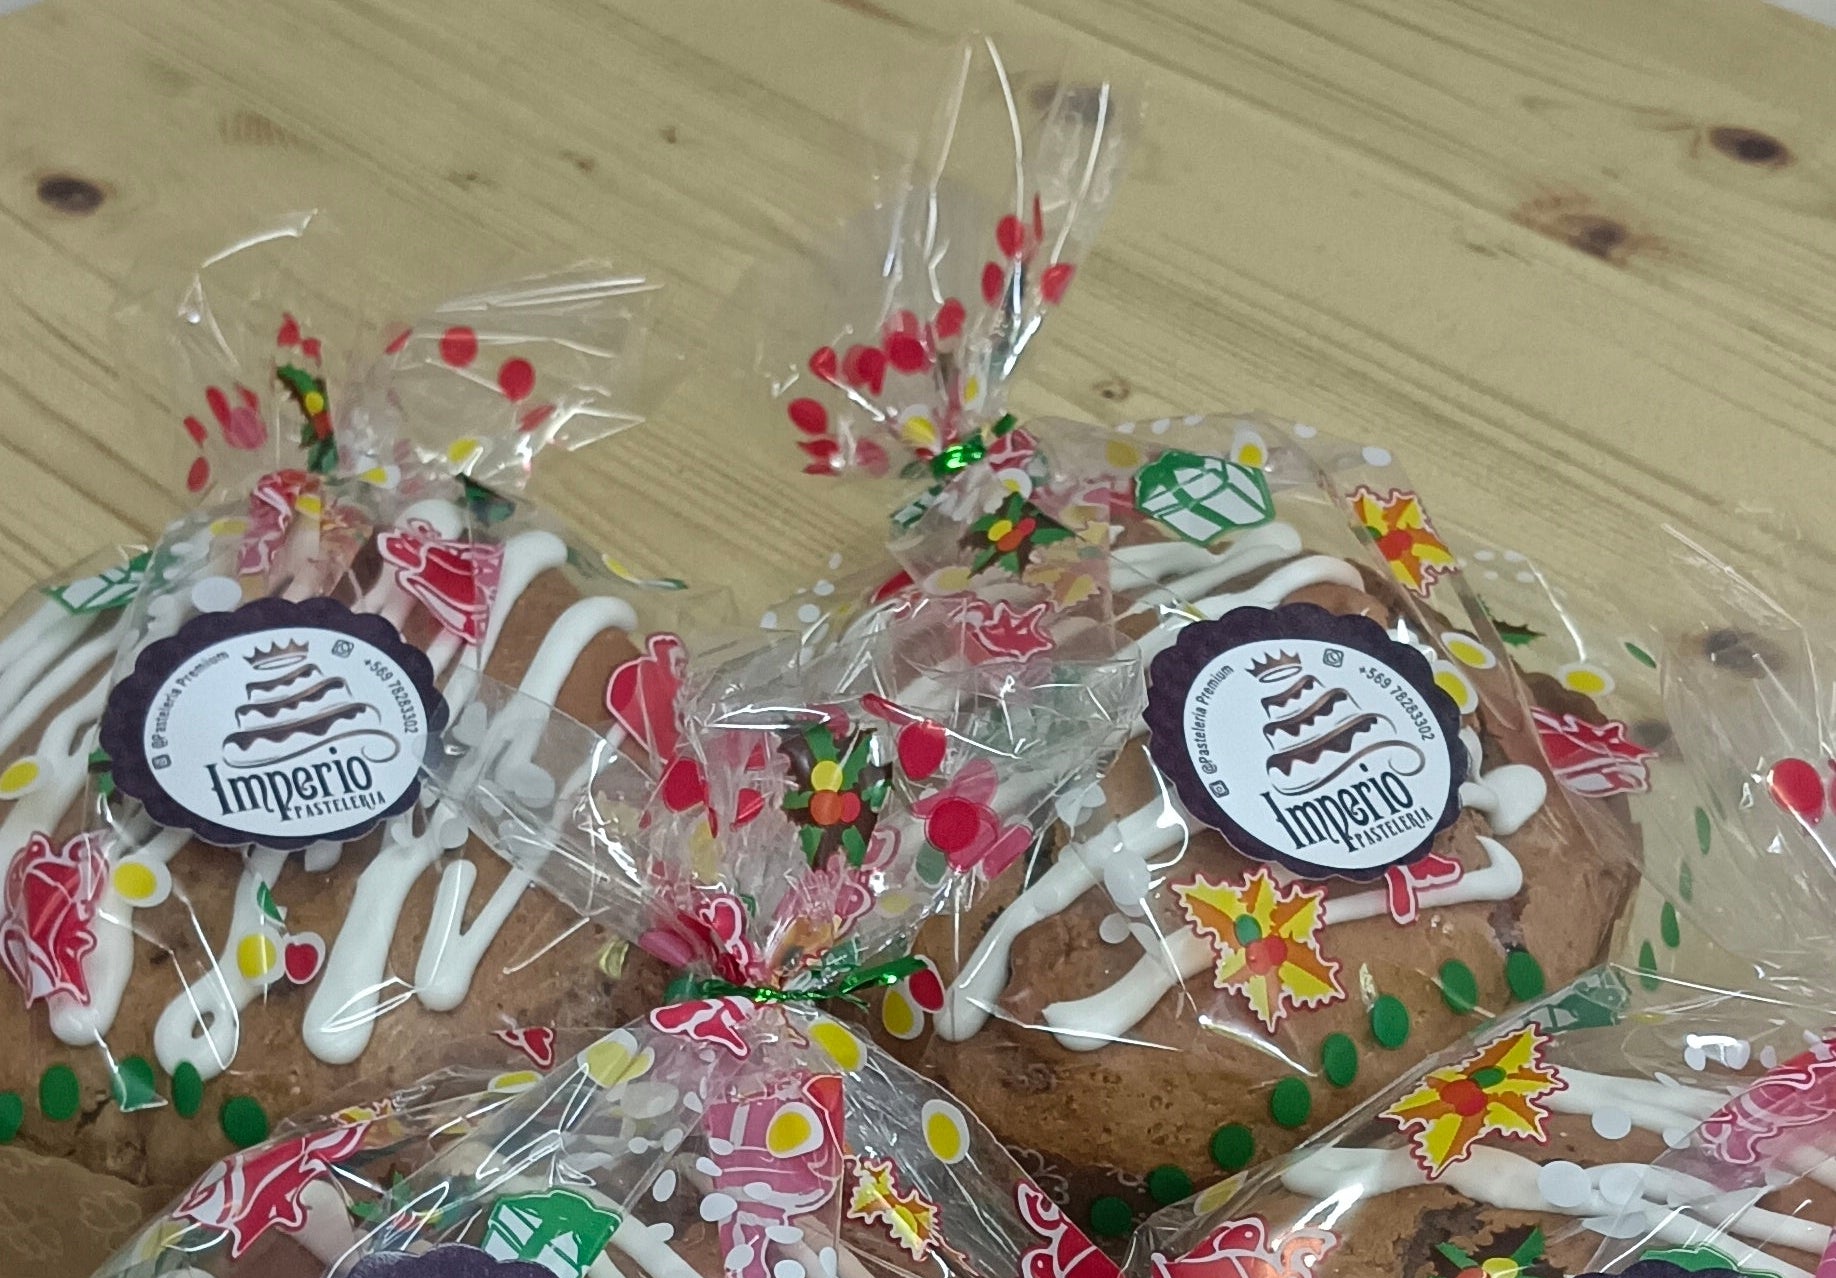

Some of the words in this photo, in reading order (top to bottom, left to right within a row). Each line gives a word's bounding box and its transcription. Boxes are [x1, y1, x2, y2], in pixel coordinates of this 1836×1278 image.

[175, 651, 230, 687] Premium
[363, 658, 394, 682] +569
[388, 679, 419, 734] 78283302
[1195, 664, 1235, 706] Premium
[1358, 666, 1392, 690] +569
[1390, 685, 1436, 741] 78283302
[203, 747, 373, 822] Imperio
[293, 791, 386, 819] PASTELERIA
[1259, 762, 1415, 853] Imperio
[1353, 806, 1434, 849] PASTELERIA
